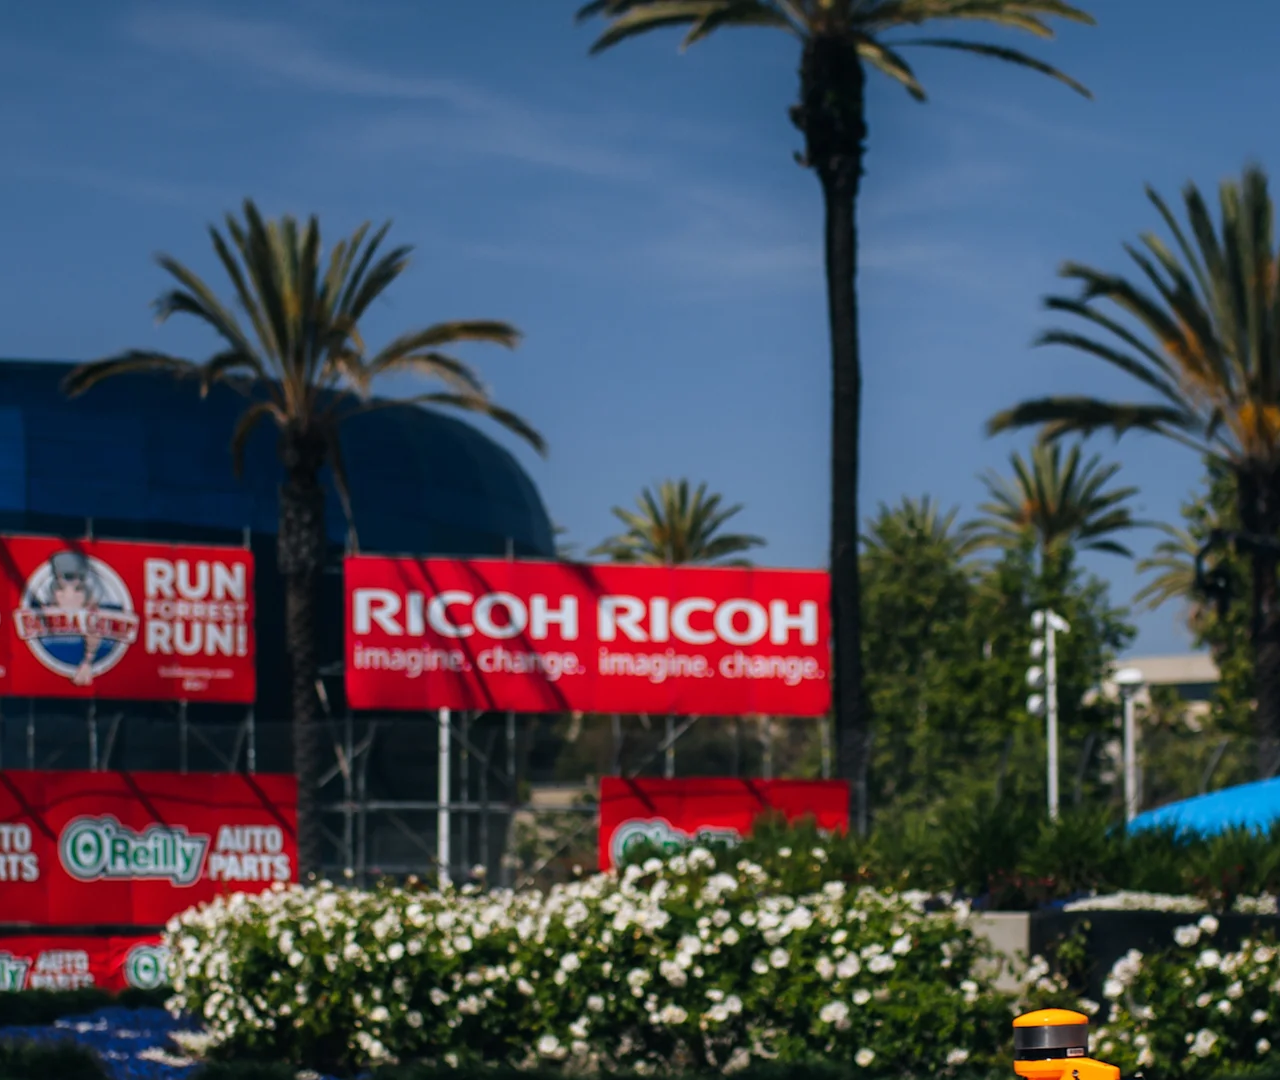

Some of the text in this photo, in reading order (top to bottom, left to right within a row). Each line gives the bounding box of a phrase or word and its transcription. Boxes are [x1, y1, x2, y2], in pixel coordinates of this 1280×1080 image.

[144, 557, 246, 600] RUN
[145, 600, 249, 622] FORREST
[352, 588, 818, 646] RICOH RICOH
[145, 619, 248, 657] RUN!
[353, 641, 586, 682] imagine. change.
[598, 647, 825, 687] imagine. change.
[219, 824, 283, 855] AUTO
[209, 853, 292, 883] PARTS
[36, 949, 89, 975] AUTO
